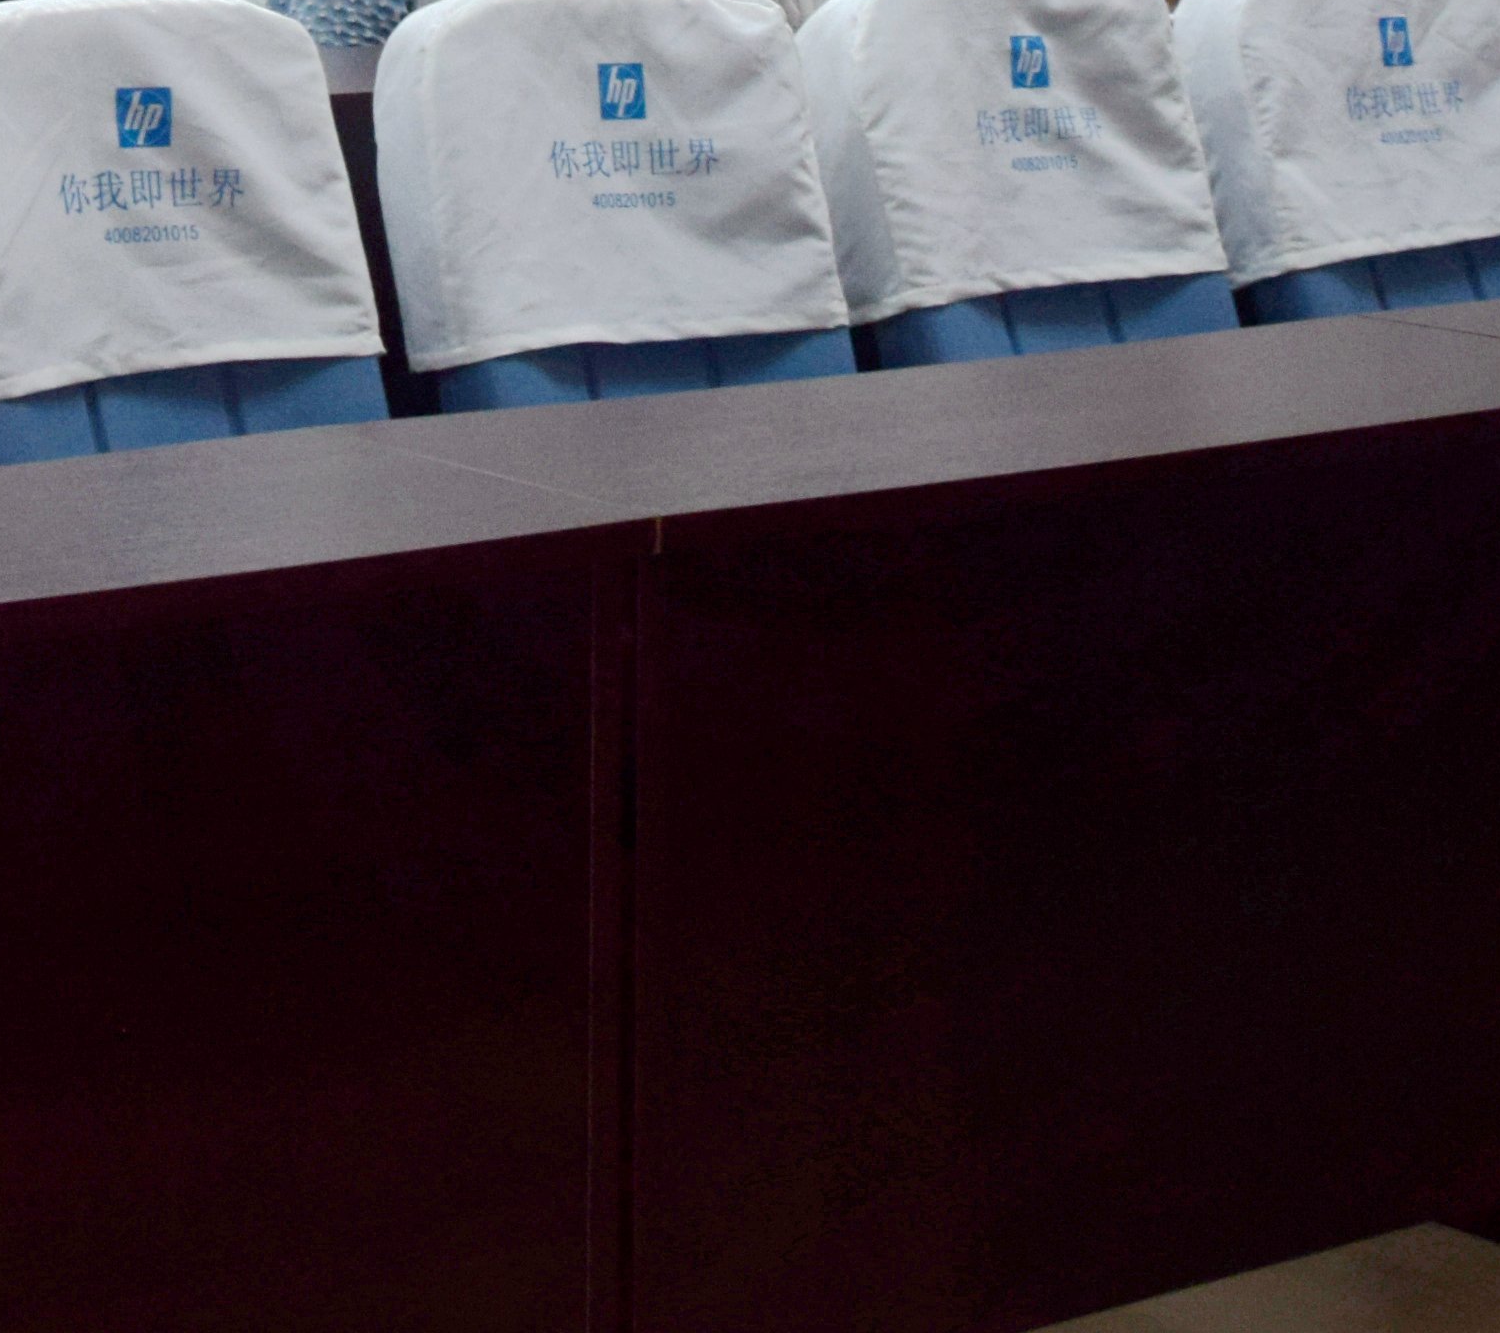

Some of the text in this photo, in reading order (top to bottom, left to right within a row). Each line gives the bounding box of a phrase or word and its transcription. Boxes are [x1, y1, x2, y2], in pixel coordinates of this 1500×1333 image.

[1016, 36, 1043, 87] hp
[605, 64, 639, 118] hp
[123, 89, 164, 146] hp
[976, 107, 1104, 144] 你我即世界
[550, 138, 719, 178] 你我即世界
[60, 169, 244, 214] 你我即世界
[592, 192, 676, 209] 4008201015
[104, 226, 199, 244] 4008201015
